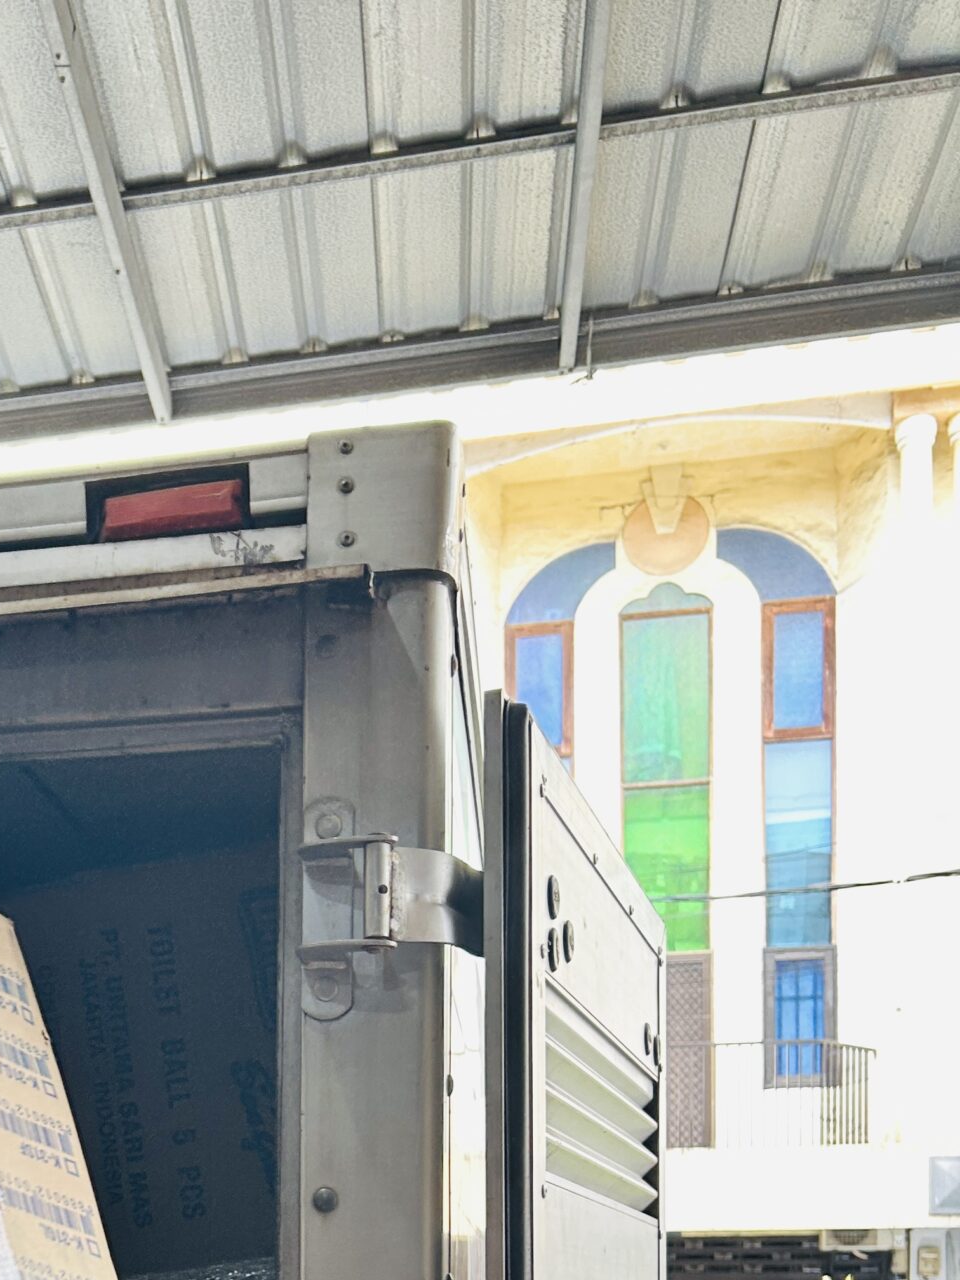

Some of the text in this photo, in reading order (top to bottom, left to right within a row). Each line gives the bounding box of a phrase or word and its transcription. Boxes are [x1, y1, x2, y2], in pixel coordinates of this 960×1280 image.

[95, 1081, 124, 1206] INDONESIA
[119, 1101, 146, 1163] SARI
[160, 1039, 191, 1110] BALL
[178, 1164, 207, 1221] PCS
[128, 1171, 154, 1229] MAS
